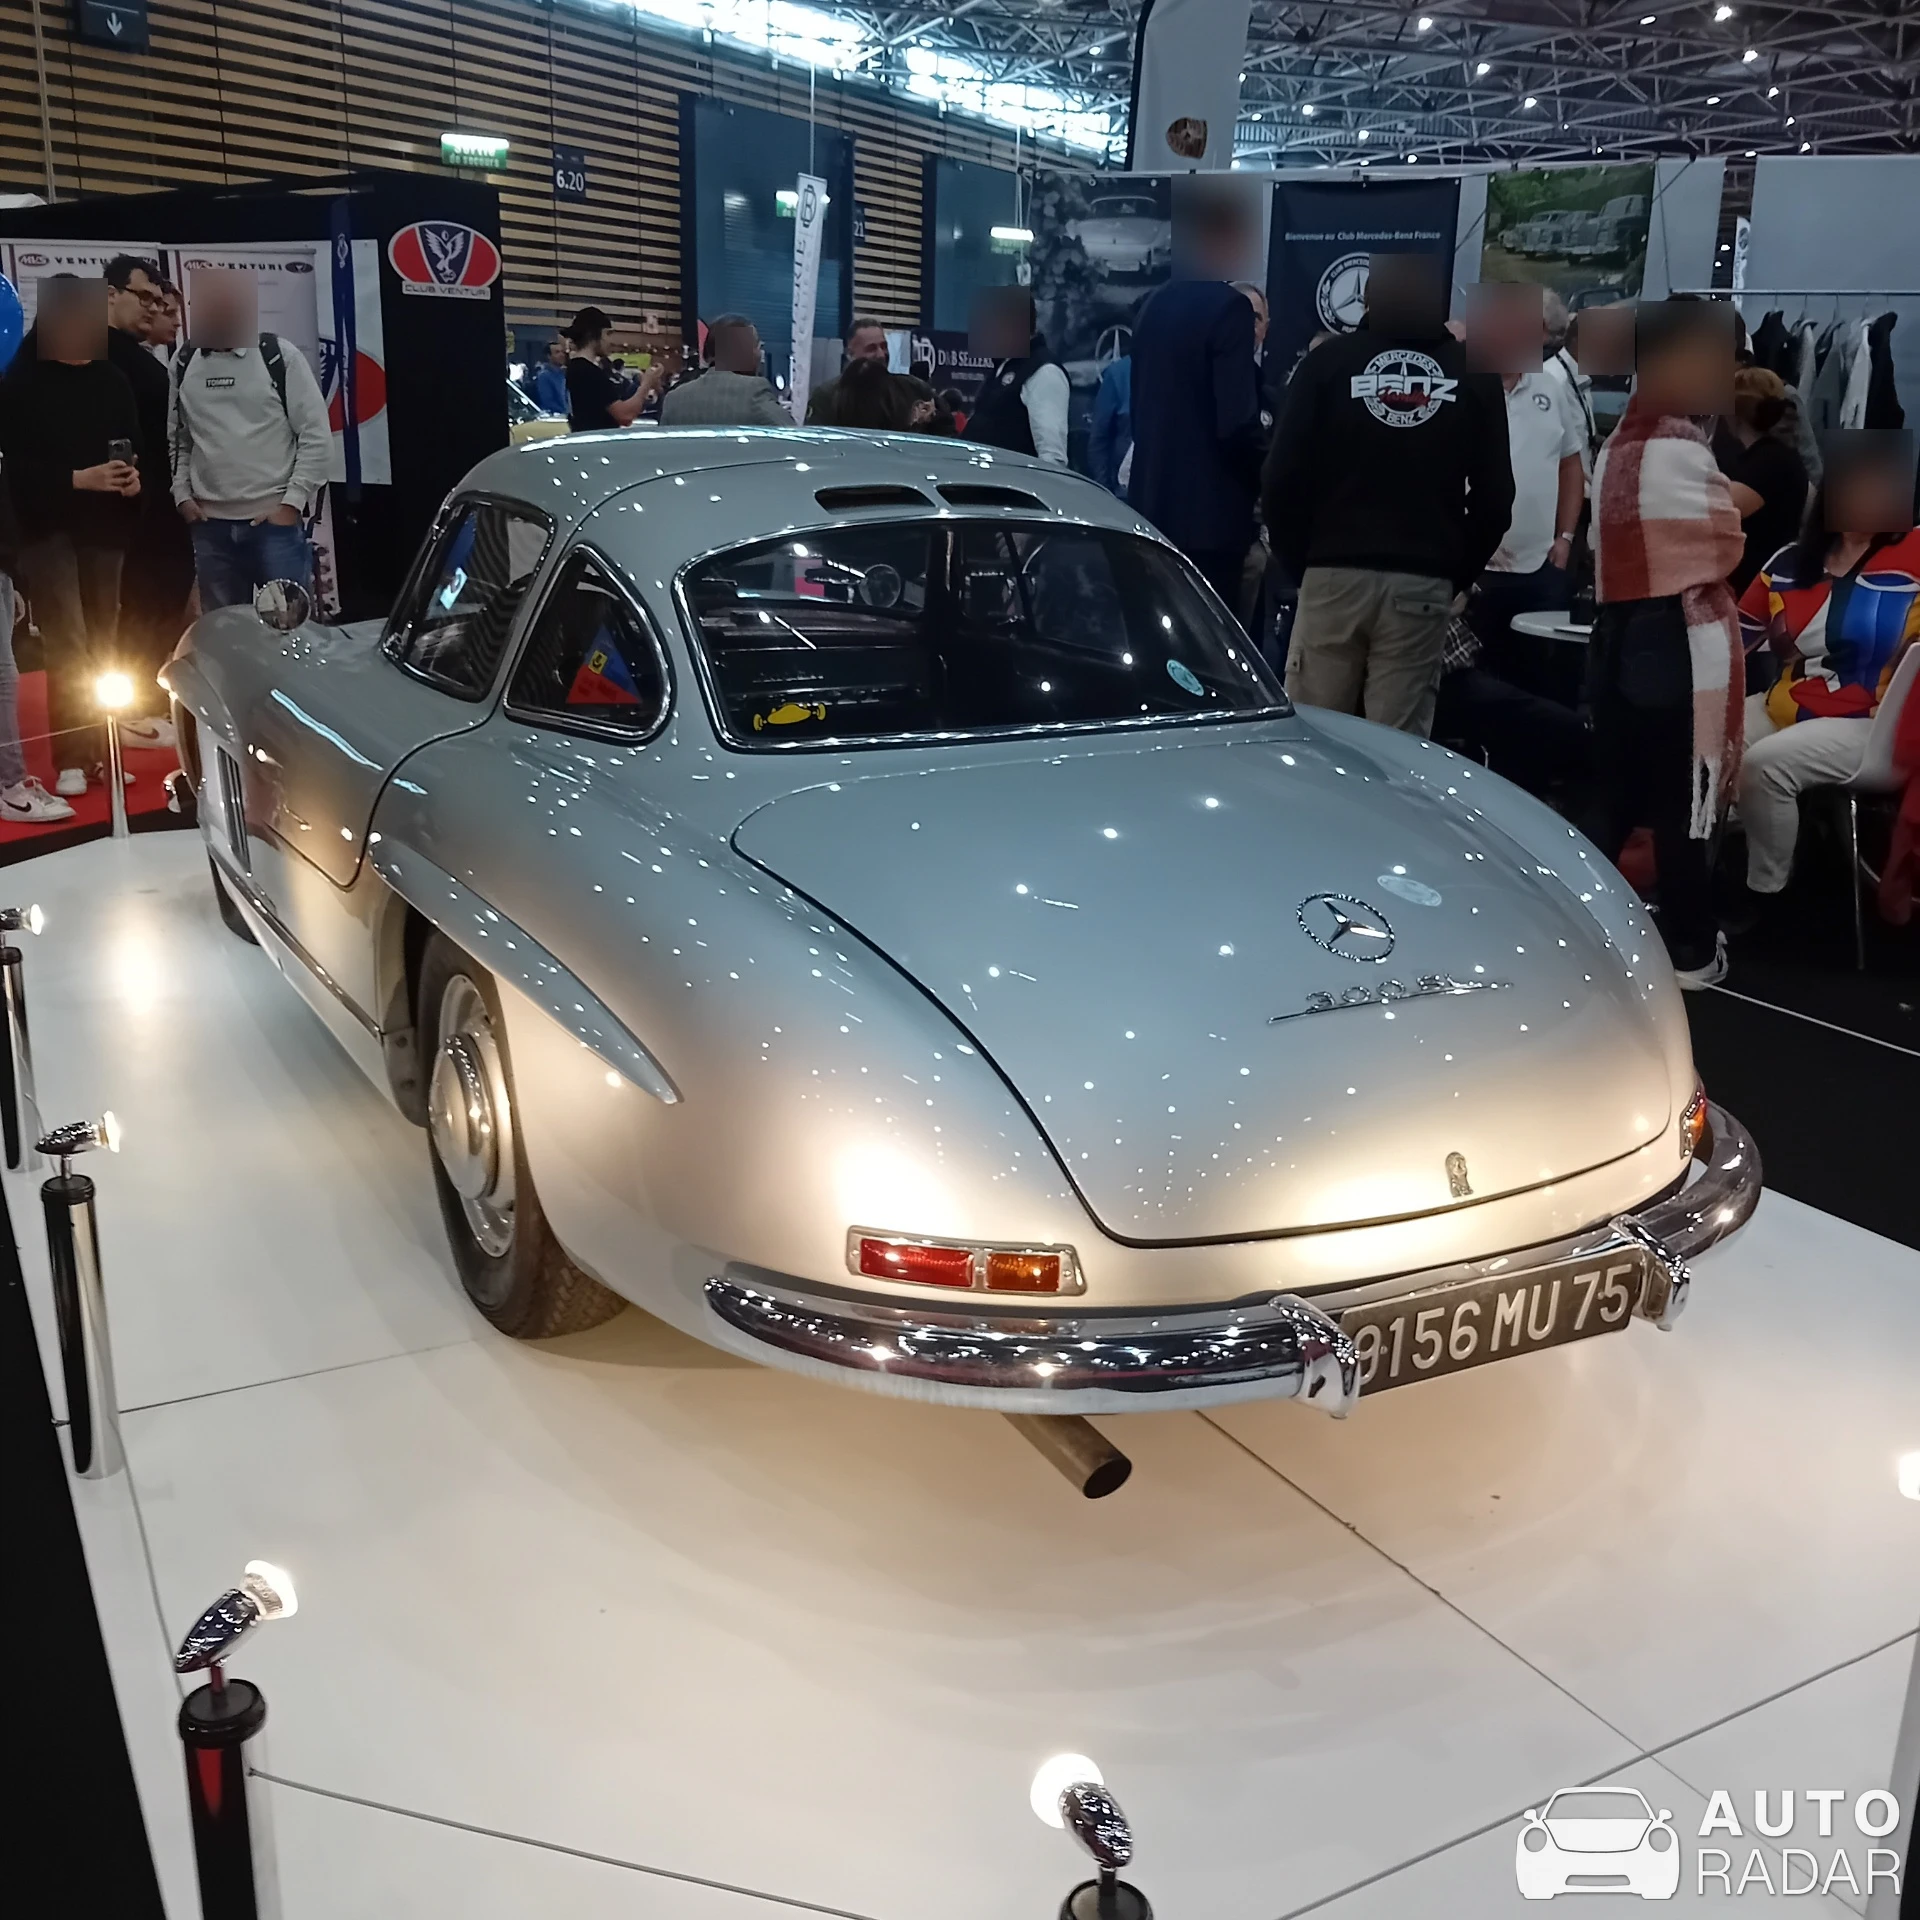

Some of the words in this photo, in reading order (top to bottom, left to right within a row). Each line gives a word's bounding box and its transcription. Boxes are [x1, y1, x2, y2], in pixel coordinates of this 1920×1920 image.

[556, 169, 585, 192] 6.20
[1284, 231, 1324, 241] Bienvenue
[1337, 231, 1356, 240] Club
[1356, 230, 1414, 240] Mercedes-Benz
[1414, 230, 1441, 240] France
[54, 256, 109, 265] VENTU
[404, 284, 436, 293] CLUB
[1375, 351, 1435, 371] MERCEDES
[1386, 412, 1417, 425] BENZ
[1305, 979, 1407, 1014] 300
[1416, 973, 1484, 991] SL
[1356, 1300, 1482, 1386] 9156
[1489, 1280, 1561, 1352] MU
[1573, 1263, 1633, 1331] 75
